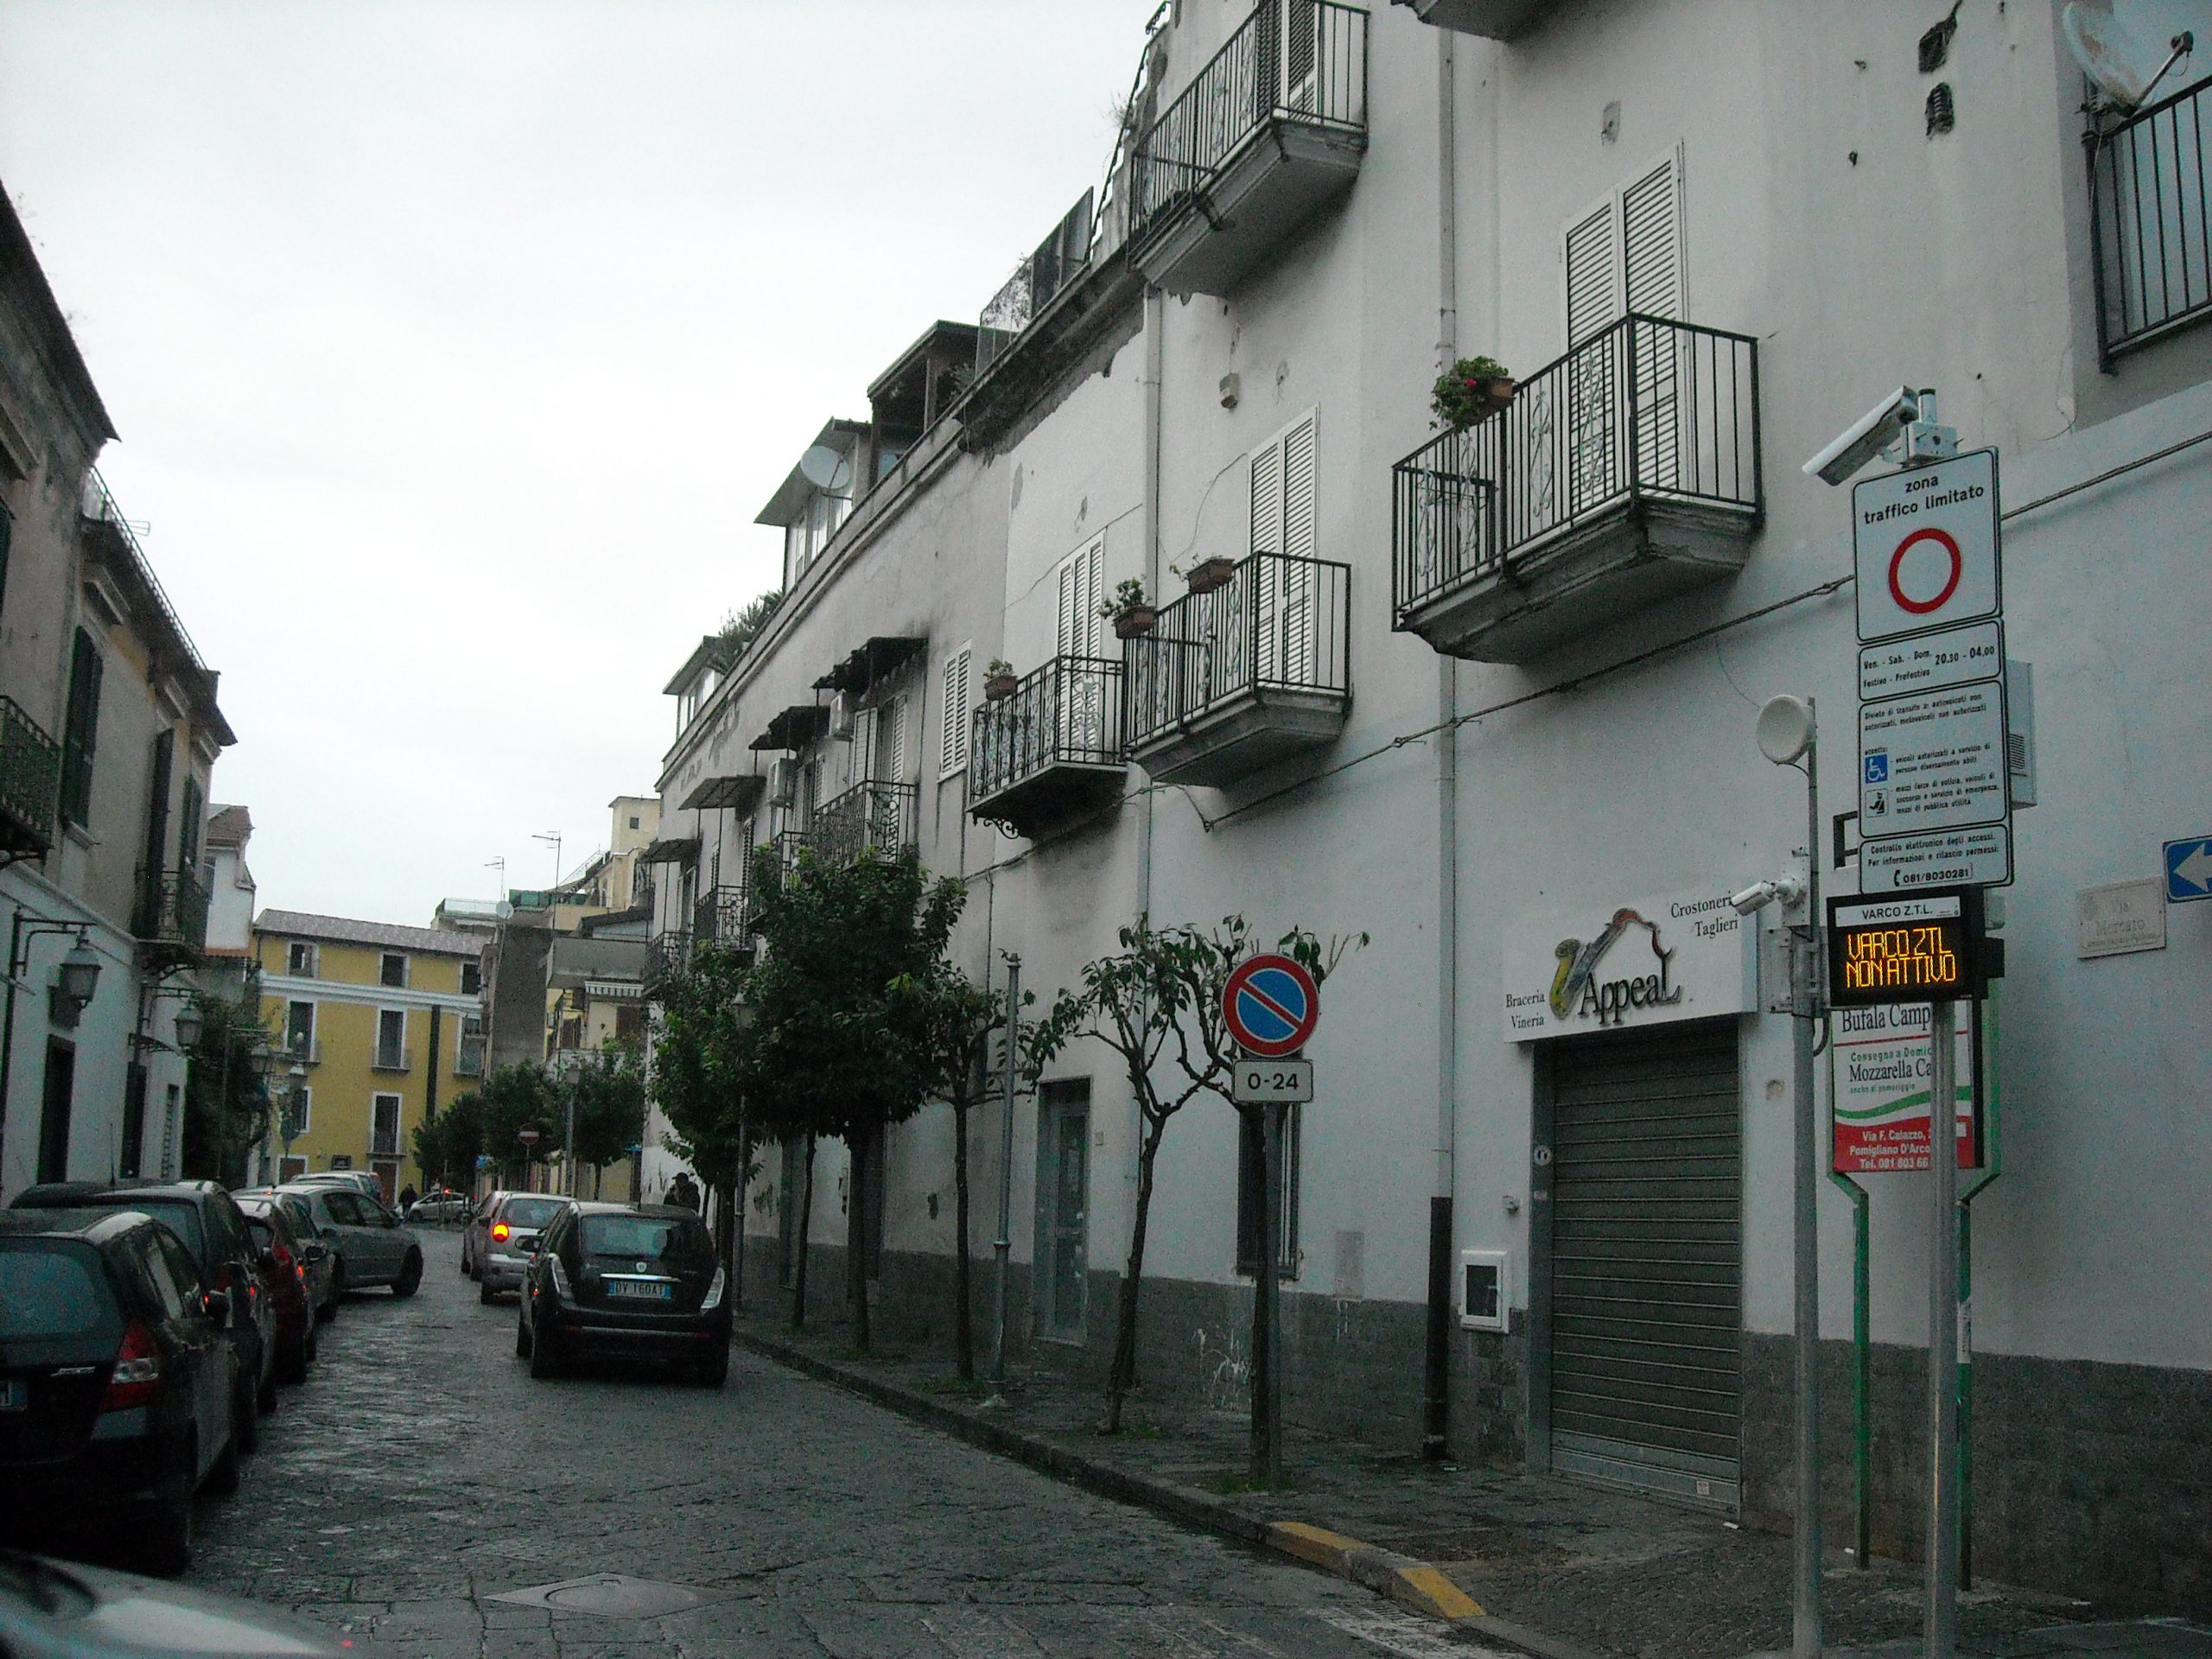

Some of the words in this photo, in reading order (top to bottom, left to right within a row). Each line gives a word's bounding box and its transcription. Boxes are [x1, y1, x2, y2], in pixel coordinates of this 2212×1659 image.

[1905, 475, 1939, 493] zona
[1864, 502, 1918, 524] traffico
[1925, 485, 1984, 510] limitato
[1888, 655, 1904, 665] Sab.
[1914, 649, 1932, 660] Dom.
[1935, 652, 1960, 665] 20.30
[1969, 645, 1995, 659] 04.00
[1895, 668, 1930, 682] Prefestivo
[1868, 857, 1879, 867] Per
[1903, 868, 1969, 883] 081/8030281
[1670, 891, 1732, 919] Crostoneri
[1862, 906, 1901, 920] VARCO
[1904, 904, 1933, 916] Z.T.L.
[1694, 913, 1738, 939] Taglieri
[1847, 928, 1910, 960] VARCO
[1913, 926, 1952, 957] ZTL
[1846, 959, 1884, 988] NON
[1886, 953, 1957, 986] ATTIVO
[1505, 988, 1546, 1008] Braceria
[1511, 1012, 1545, 1029] Vineria
[1842, 1005, 1885, 1033] Bufala
[1849, 1059, 1912, 1082] Mozzarella
[1248, 1071, 1299, 1090] 0-24
[1862, 1129, 1878, 1141] Via
[1879, 1129, 1887, 1140] F.
[1849, 1144, 1898, 1156] Pomigliano
[1900, 1142, 1931, 1155] D'Arco
[1859, 1158, 1876, 1169] Tel.
